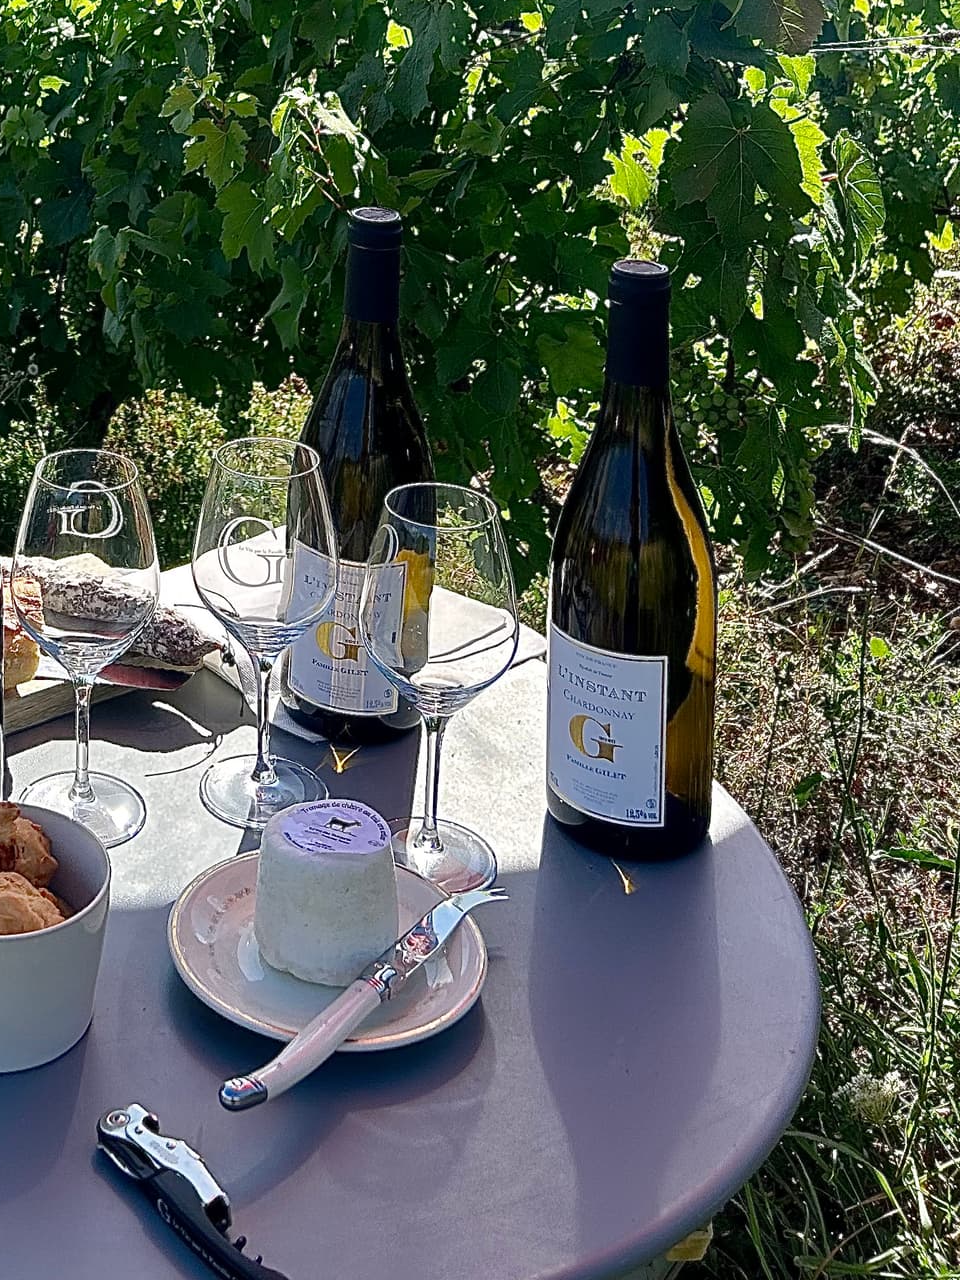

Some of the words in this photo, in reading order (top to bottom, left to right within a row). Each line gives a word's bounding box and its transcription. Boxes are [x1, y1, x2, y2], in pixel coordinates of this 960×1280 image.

[218, 516, 286, 588] G
[315, 621, 366, 663] G
[340, 667, 369, 677] GILET
[558, 664, 647, 703] L'INSTANT
[563, 688, 636, 720] CHARDONNAY
[568, 713, 624, 764] G
[595, 767, 627, 781] GILET
